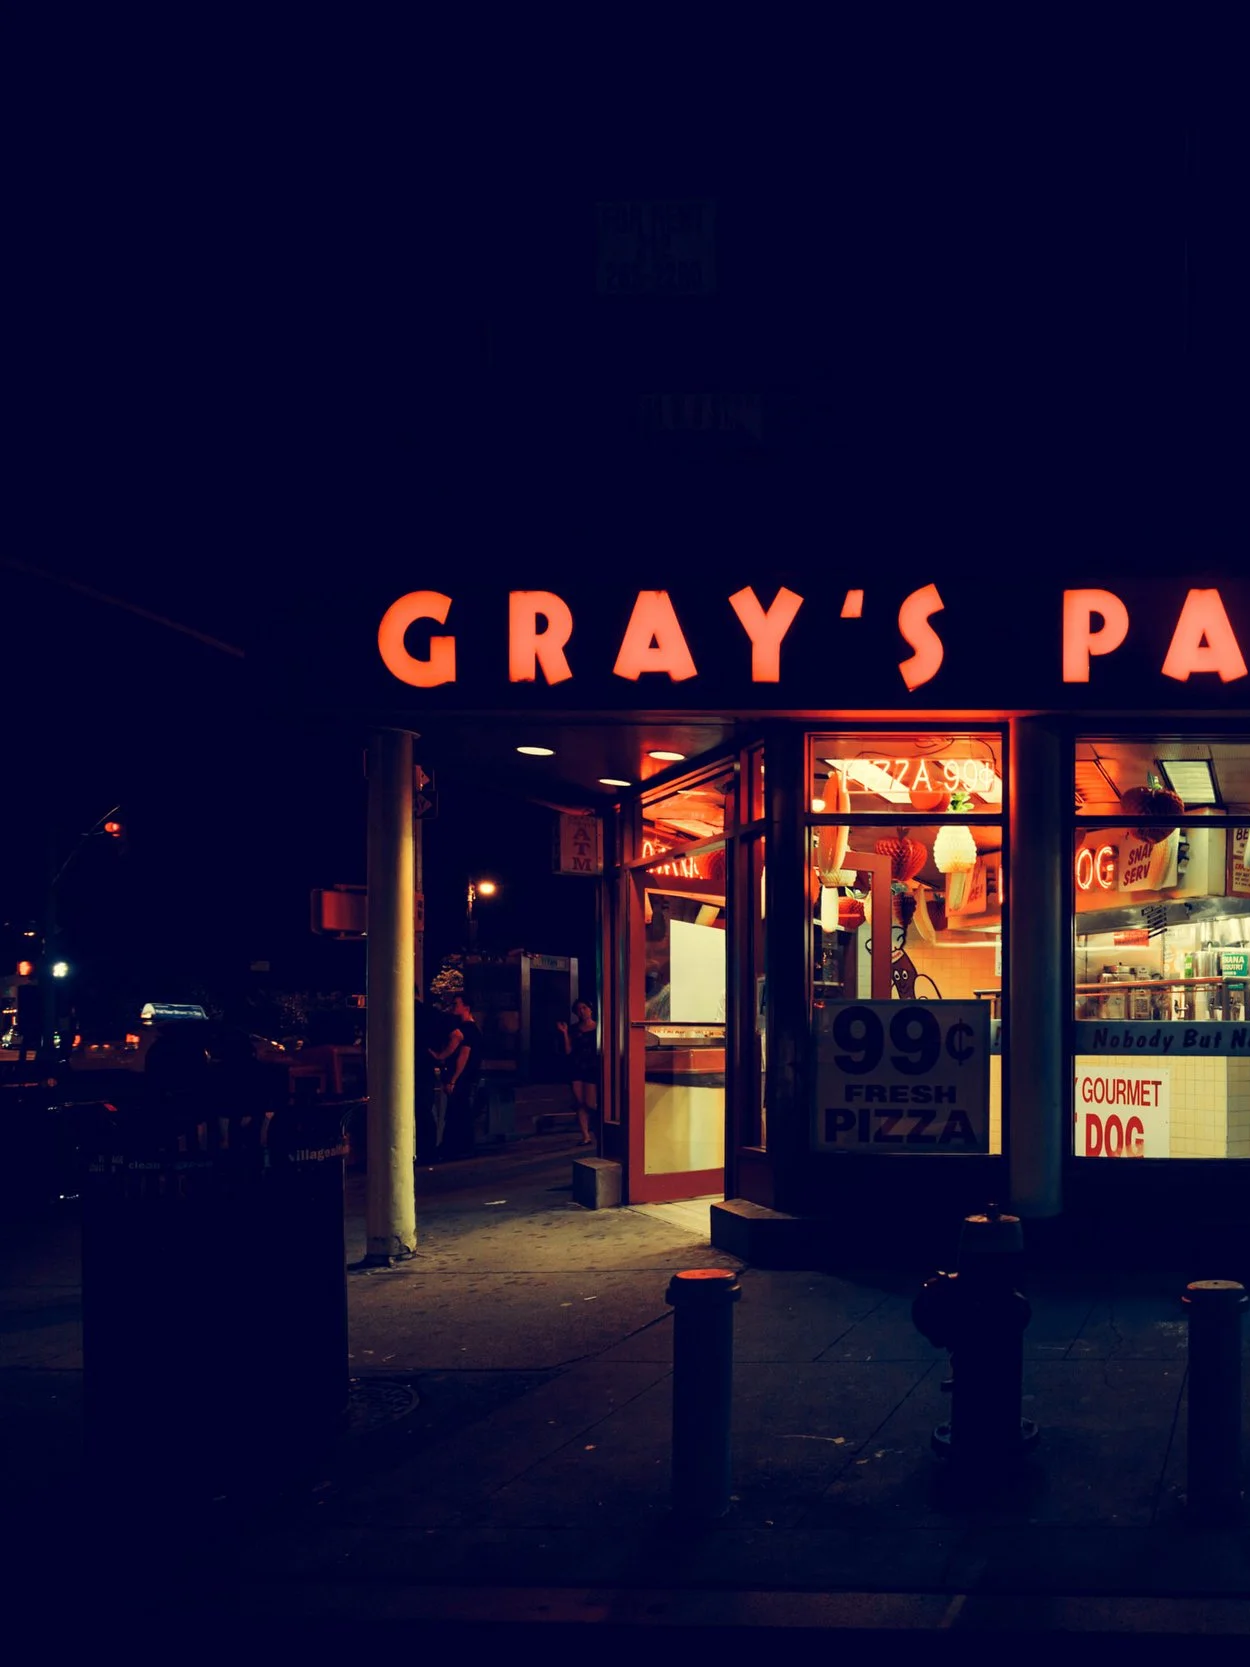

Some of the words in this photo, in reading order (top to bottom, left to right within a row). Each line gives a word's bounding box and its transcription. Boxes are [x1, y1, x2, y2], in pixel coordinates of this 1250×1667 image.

[377, 583, 945, 692] GRAY'S
[572, 827, 592, 872] ATM
[833, 1005, 975, 1076] 99¢
[1093, 1028, 1174, 1052] Nobody
[1183, 1028, 1222, 1049] But
[844, 1084, 957, 1105] FRESH
[1082, 1076, 1162, 1107] GOURMET
[824, 1108, 979, 1144] PIZZA
[1085, 1113, 1145, 1158] DOG
